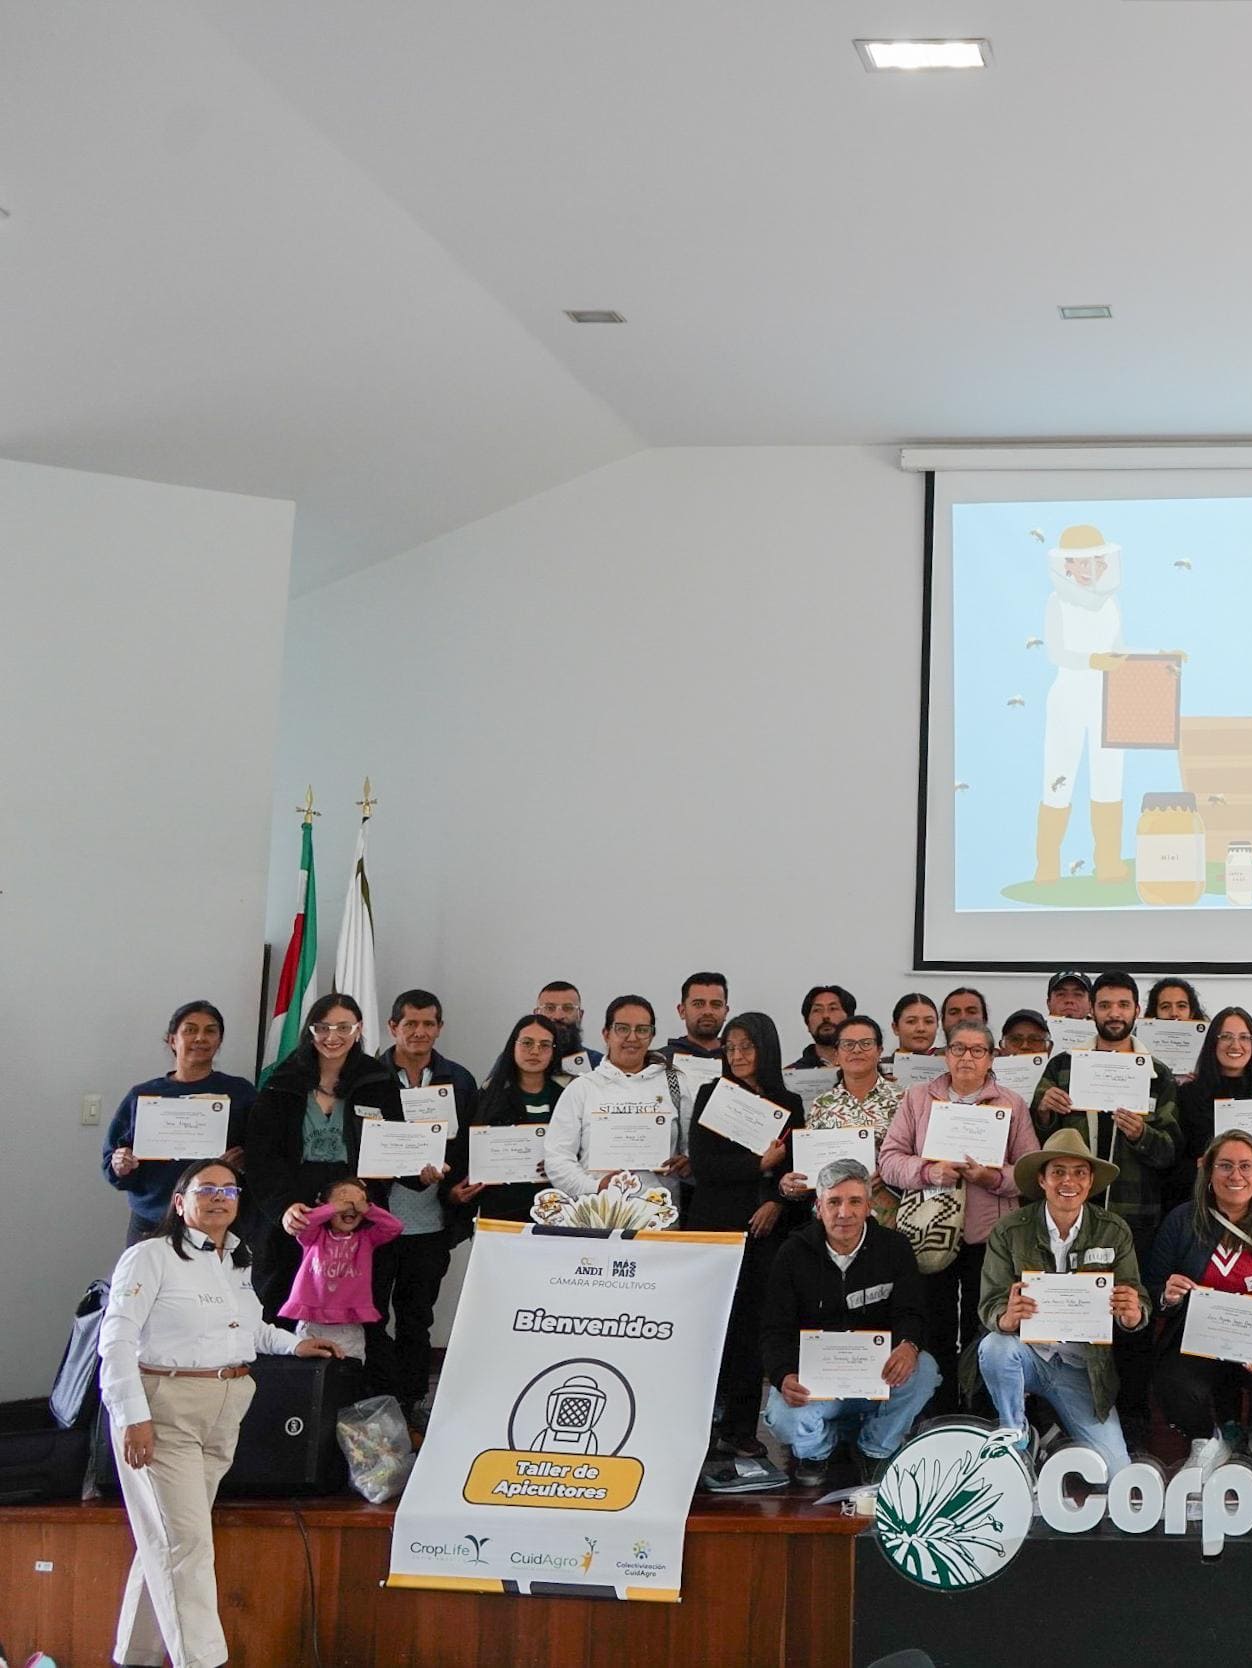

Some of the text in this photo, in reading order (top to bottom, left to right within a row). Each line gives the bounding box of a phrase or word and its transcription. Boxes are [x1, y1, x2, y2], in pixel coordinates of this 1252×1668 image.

[575, 1266, 603, 1277] ANDI
[592, 1279, 657, 1291] PROCULTIVOS
[513, 1308, 674, 1340] Bienvenidos
[516, 1460, 599, 1480] Taller de
[492, 1478, 607, 1501] Apicultores
[410, 1541, 470, 1557] CropLife
[510, 1551, 578, 1568] CuidAgro
[624, 1569, 657, 1578] CuidAgro
